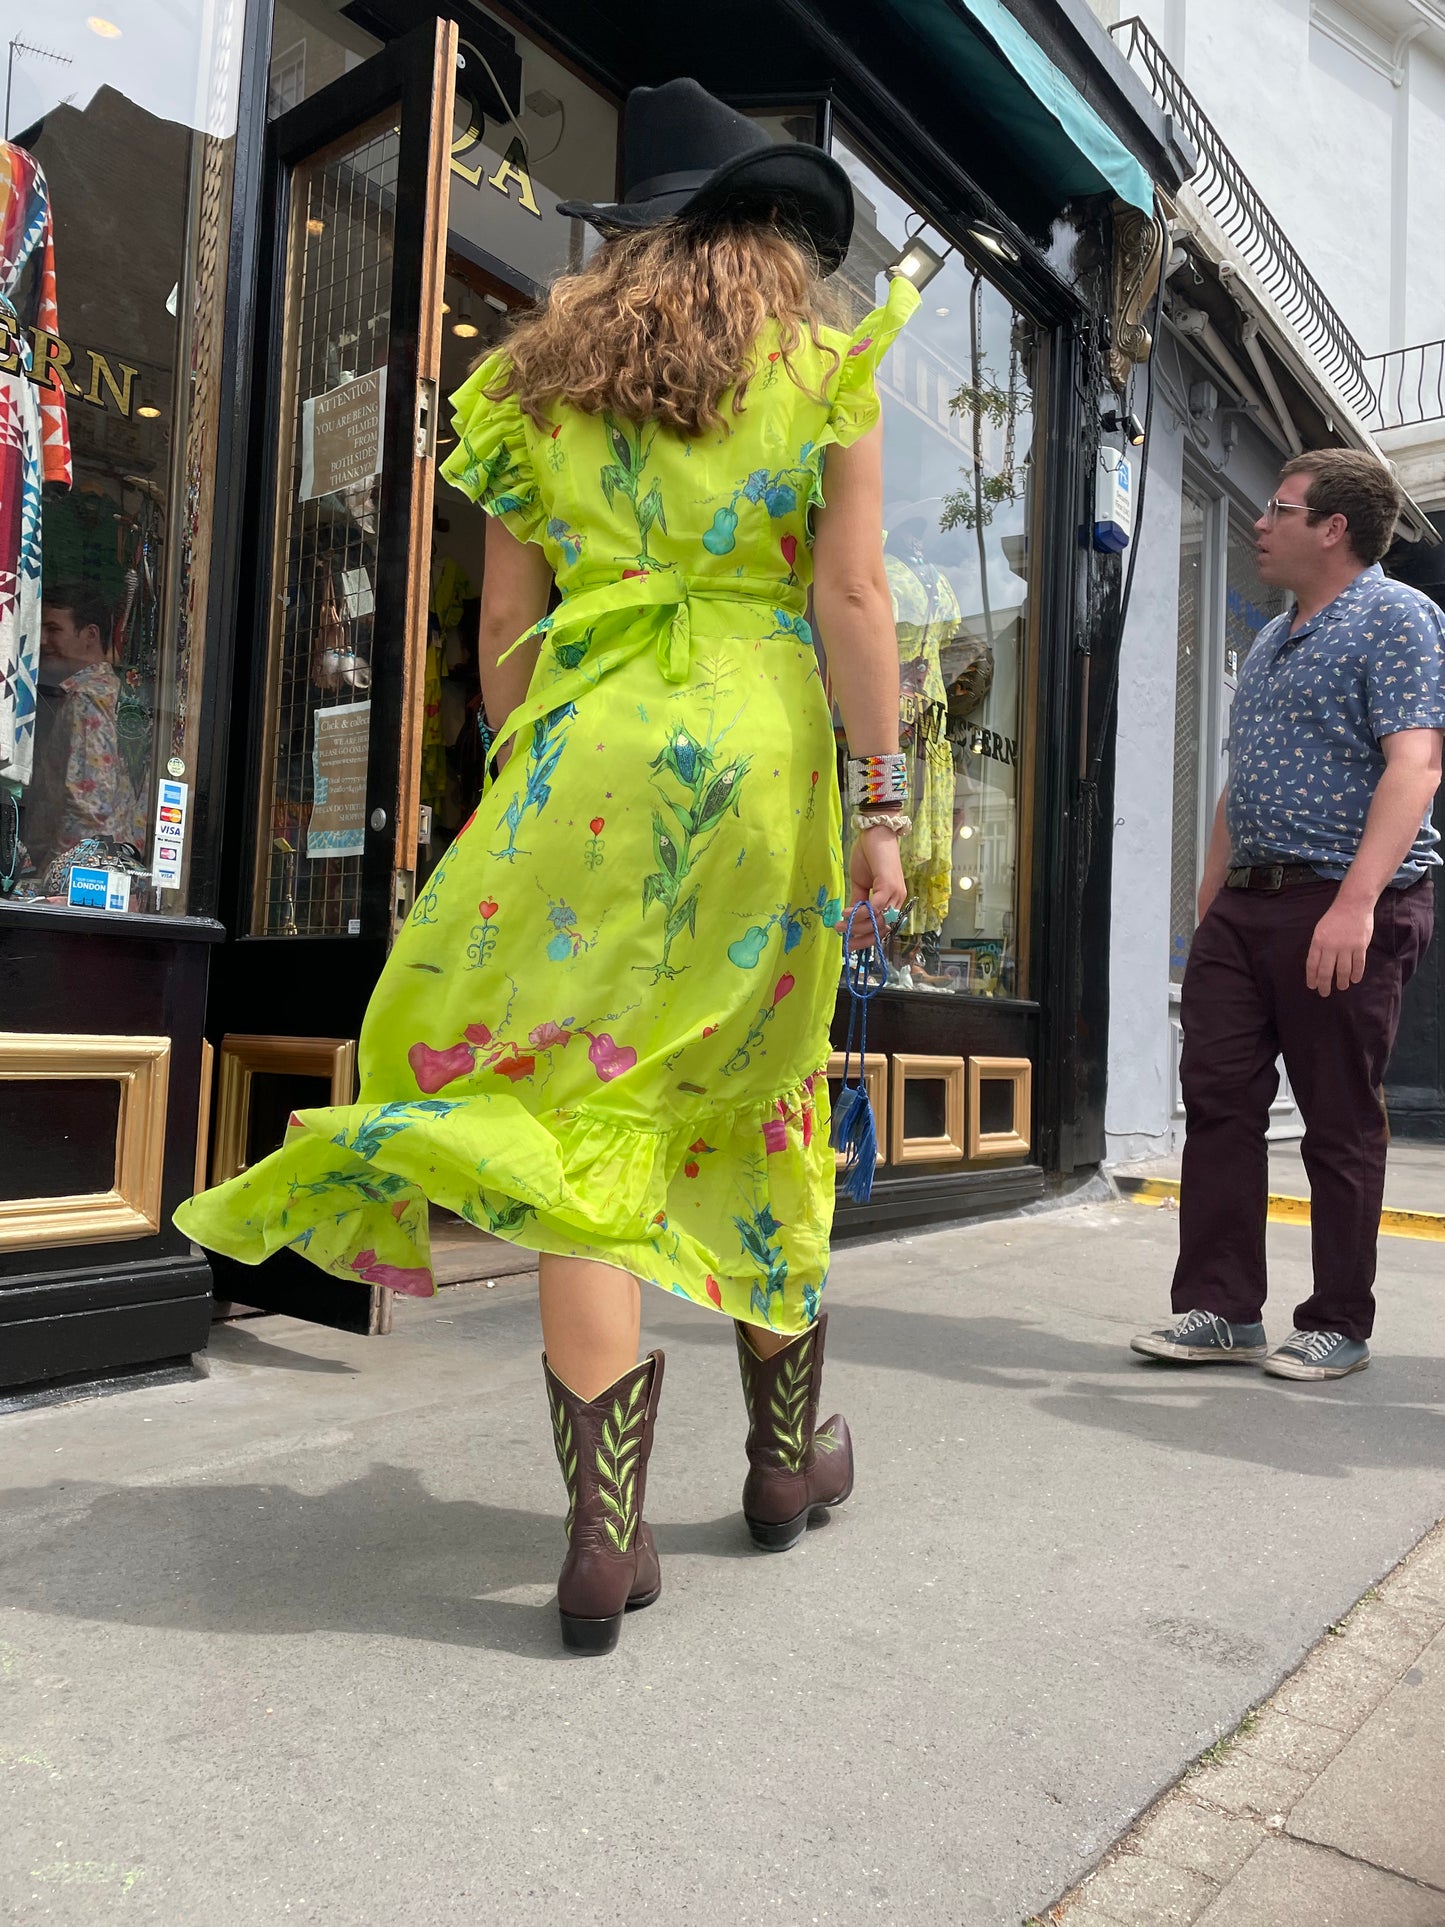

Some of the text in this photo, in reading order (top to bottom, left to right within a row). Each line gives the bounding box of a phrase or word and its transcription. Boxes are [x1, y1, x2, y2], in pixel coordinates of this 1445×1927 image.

[317, 378, 377, 415] ATTENTION
[315, 401, 378, 436] YOU ARE BEING
[347, 416, 378, 438] FILMED
[354, 430, 378, 449] FROM
[331, 445, 377, 473] BOTH SIDES
[330, 467, 359, 487] THANK
[320, 719, 339, 731] Click
[341, 719, 349, 729] &
[160, 825, 181, 836] VISA
[72, 880, 106, 892] LONDON
